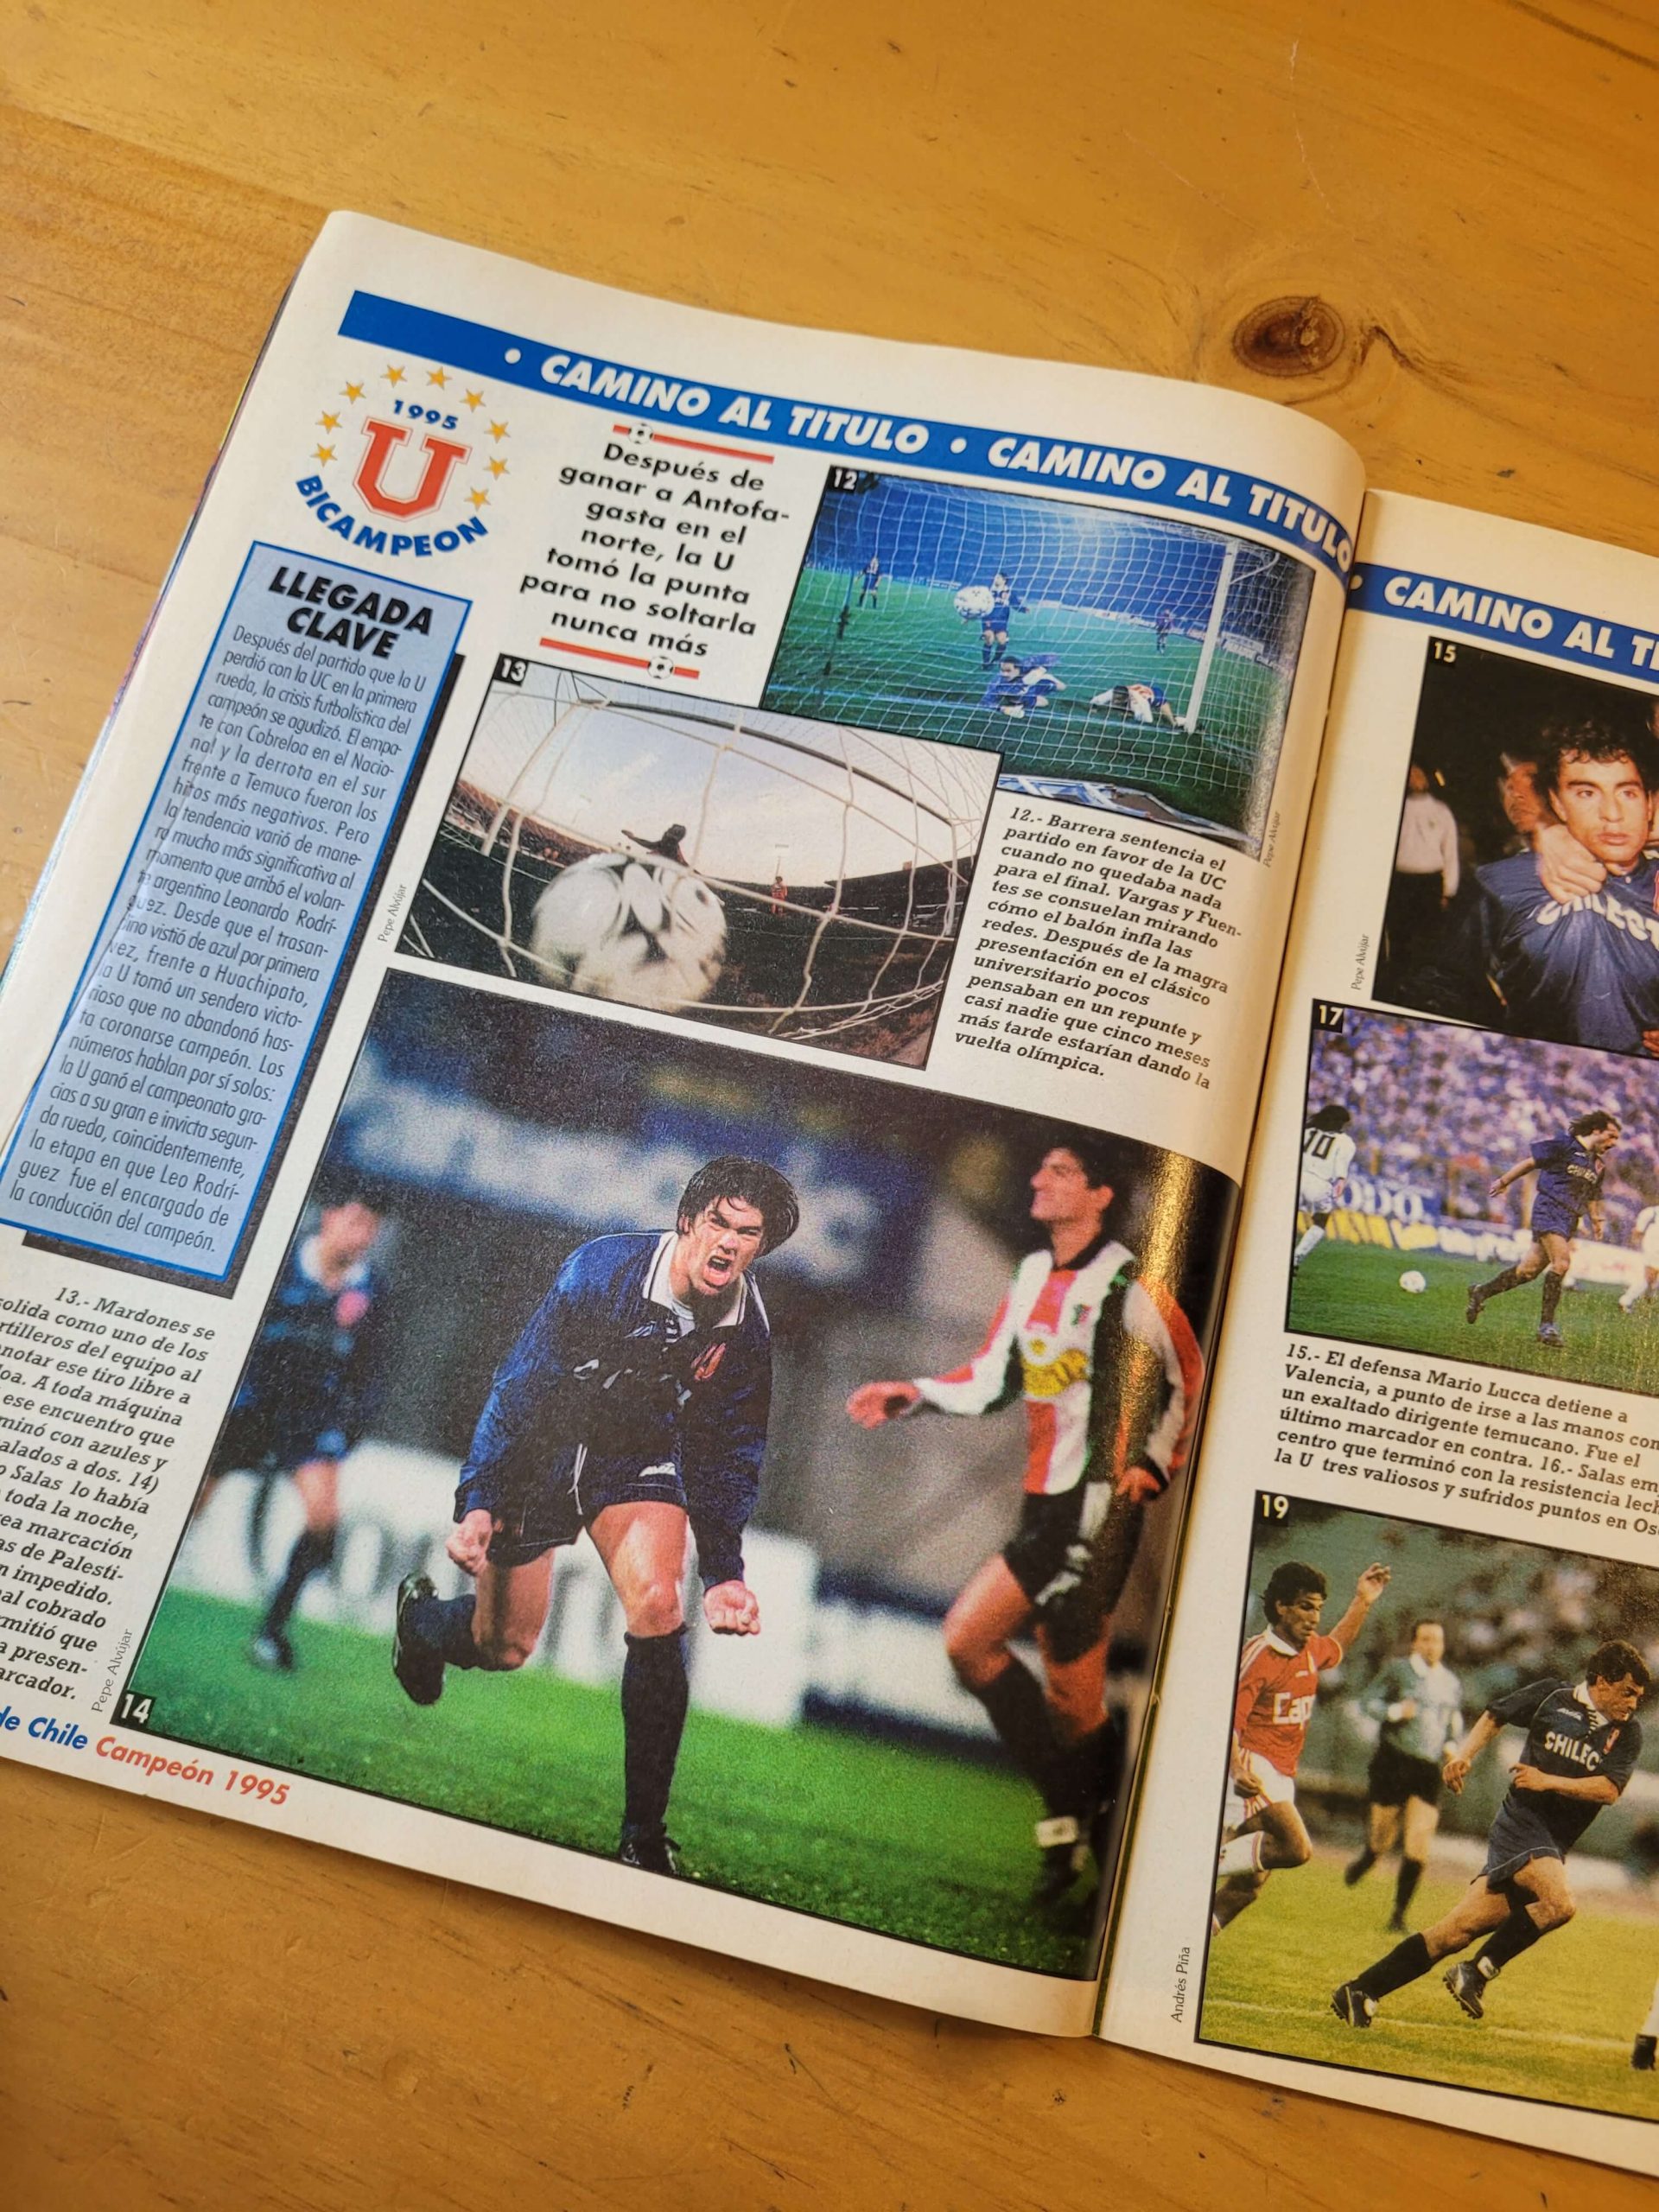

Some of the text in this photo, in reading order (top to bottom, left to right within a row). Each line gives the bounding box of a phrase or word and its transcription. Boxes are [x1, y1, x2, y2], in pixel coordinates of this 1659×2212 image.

[393, 399, 457, 431] 1995
[541, 355, 929, 454] CAMINO AL TITULO
[353, 416, 473, 522] U
[558, 467, 790, 523] ganar a Antofa-
[603, 442, 765, 492] Después de
[833, 469, 856, 492] 12
[296, 475, 489, 558] BICAMPEON
[586, 502, 747, 545] gasta en el
[988, 438, 1351, 573] CAMINO AL TITULO
[546, 547, 750, 605] tomó la punta
[581, 529, 735, 572] norte, la U
[269, 566, 435, 636] LLEGADA
[519, 575, 757, 636] para no soltarla
[1383, 576, 1553, 639] CAMINO
[1562, 620, 1614, 658] AL
[232, 624, 427, 692] Después del partido que la U
[287, 607, 399, 659] CLAVE
[550, 612, 709, 657] nunca más
[1433, 642, 1456, 664] 15
[221, 650, 418, 714] perdió con la UC en la primera
[503, 658, 527, 683] 13
[1001, 827, 1227, 891] partido en favor de la UC
[1009, 806, 1227, 872] 12.- Barrera sentencia el
[993, 863, 1242, 937] para el final. Vargas y Fuen-
[1001, 846, 1222, 911] cuando no quedaba nada
[378, 918, 395, 943] Pepe
[987, 899, 1193, 959] cómo el balón infla las
[991, 880, 1218, 948] tes se consuelan mirando
[1319, 1006, 1343, 1026] 17
[68, 1034, 276, 1103] números hablan por sí solos:
[99, 1016, 286, 1077] coronarse campeón. Los
[955, 1032, 1104, 1077] vuelta olímpica.
[9, 1179, 215, 1253] la conducción del campeón.
[54, 1287, 215, 1341] 13.- Mardones se
[54, 1314, 209, 1362] como uno de los
[31, 1375, 183, 1427] A toda máquina
[1285, 1363, 1370, 1396] Valencia,
[1376, 1384, 1388, 1396] a
[1390, 1388, 1446, 1408] punto
[1450, 1396, 1473, 1413] de
[1476, 1401, 1511, 1421] irse
[1516, 1413, 1527, 1425] a
[1530, 1411, 1559, 1430] las
[1561, 1421, 1625, 1444] manos
[1286, 1343, 1628, 1424] 15.- El defensa Mario Lucca detiene a
[49, 1430, 168, 1473] con azules y
[1281, 1388, 1641, 1468] un exaltado dirigente temucano. Fue el
[1262, 1494, 1289, 1521] 19
[20, 1542, 124, 1581] de Palesti-
[92, 1677, 114, 1713] Pepe
[120, 1694, 153, 1724] 14
[28, 1717, 88, 1750] Chile
[96, 1736, 214, 1785] Campeón
[225, 1770, 291, 1805] 1995
[1544, 1731, 1604, 1771] CHILEC
[1171, 1947, 1191, 2024] Andrés Piña
